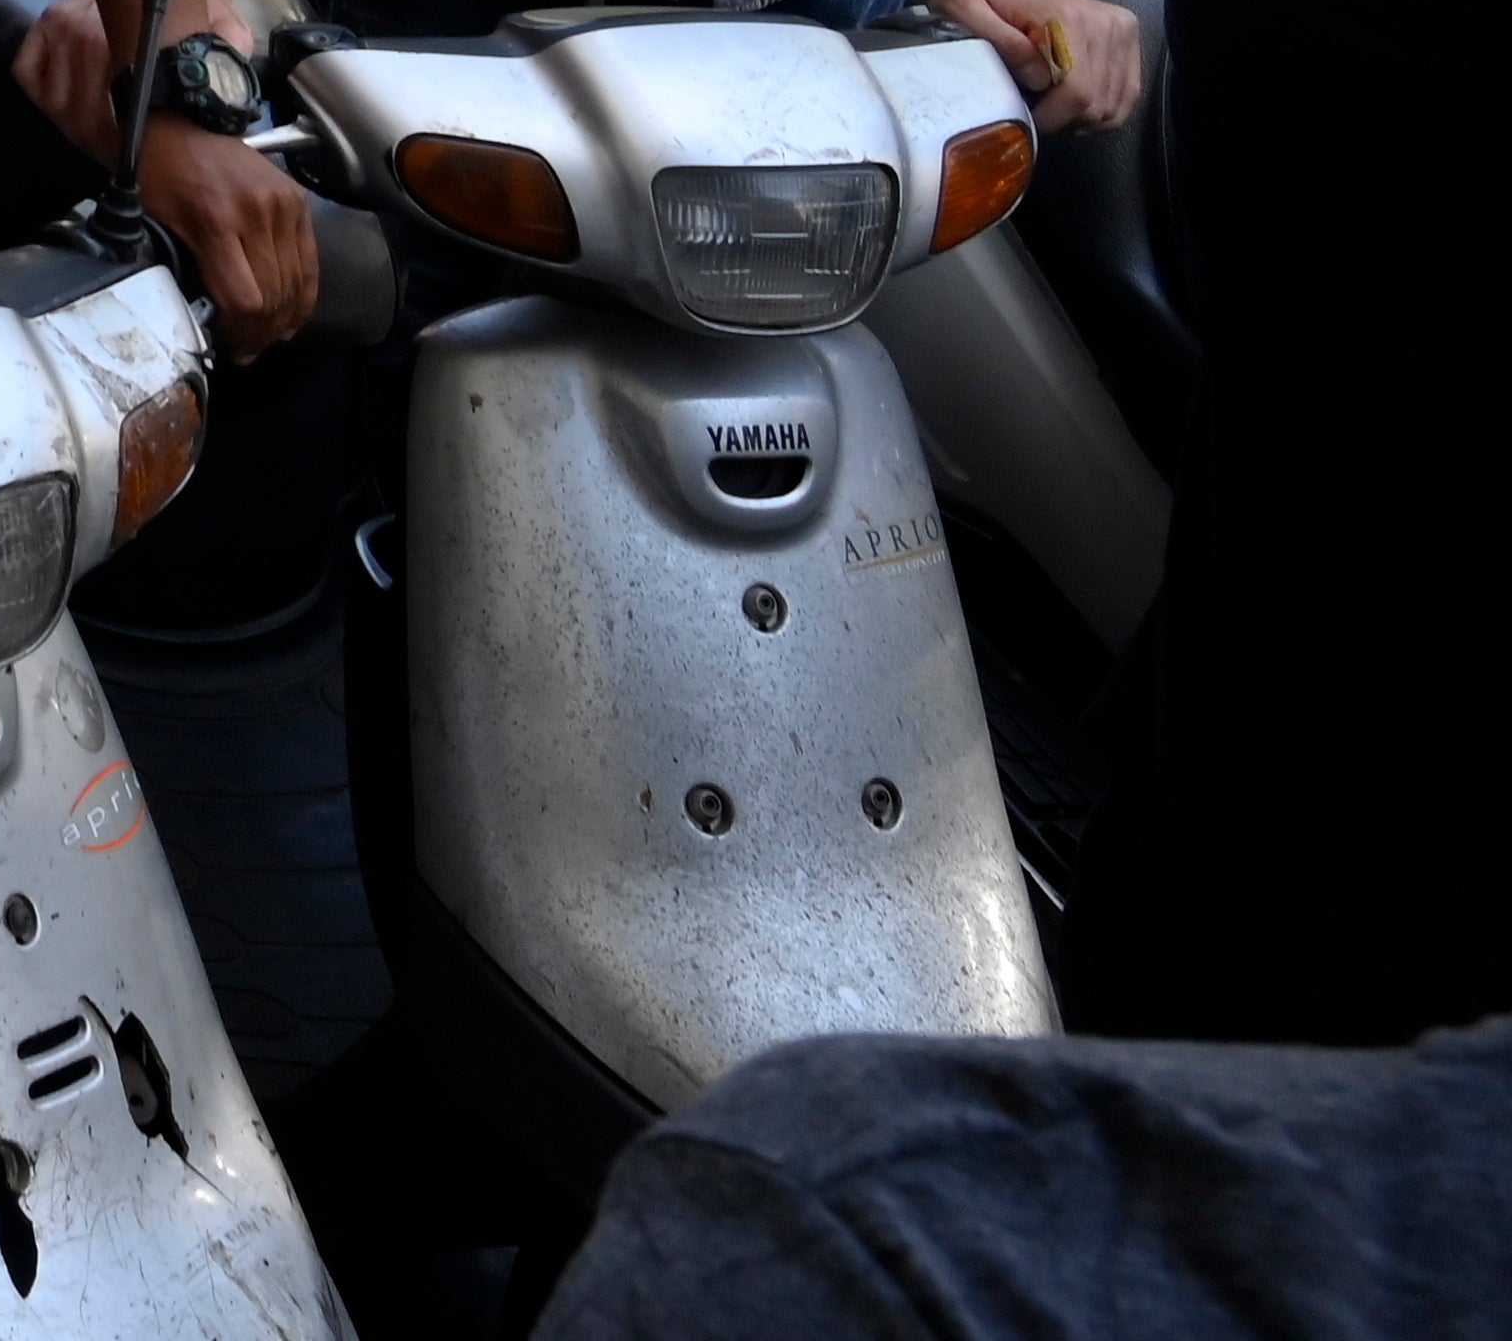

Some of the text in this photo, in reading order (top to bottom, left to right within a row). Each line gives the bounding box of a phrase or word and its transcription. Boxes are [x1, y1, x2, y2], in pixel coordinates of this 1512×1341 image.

[707, 422, 811, 452] YAMAHA
[843, 514, 941, 565] APRIO
[62, 769, 143, 846] apri
